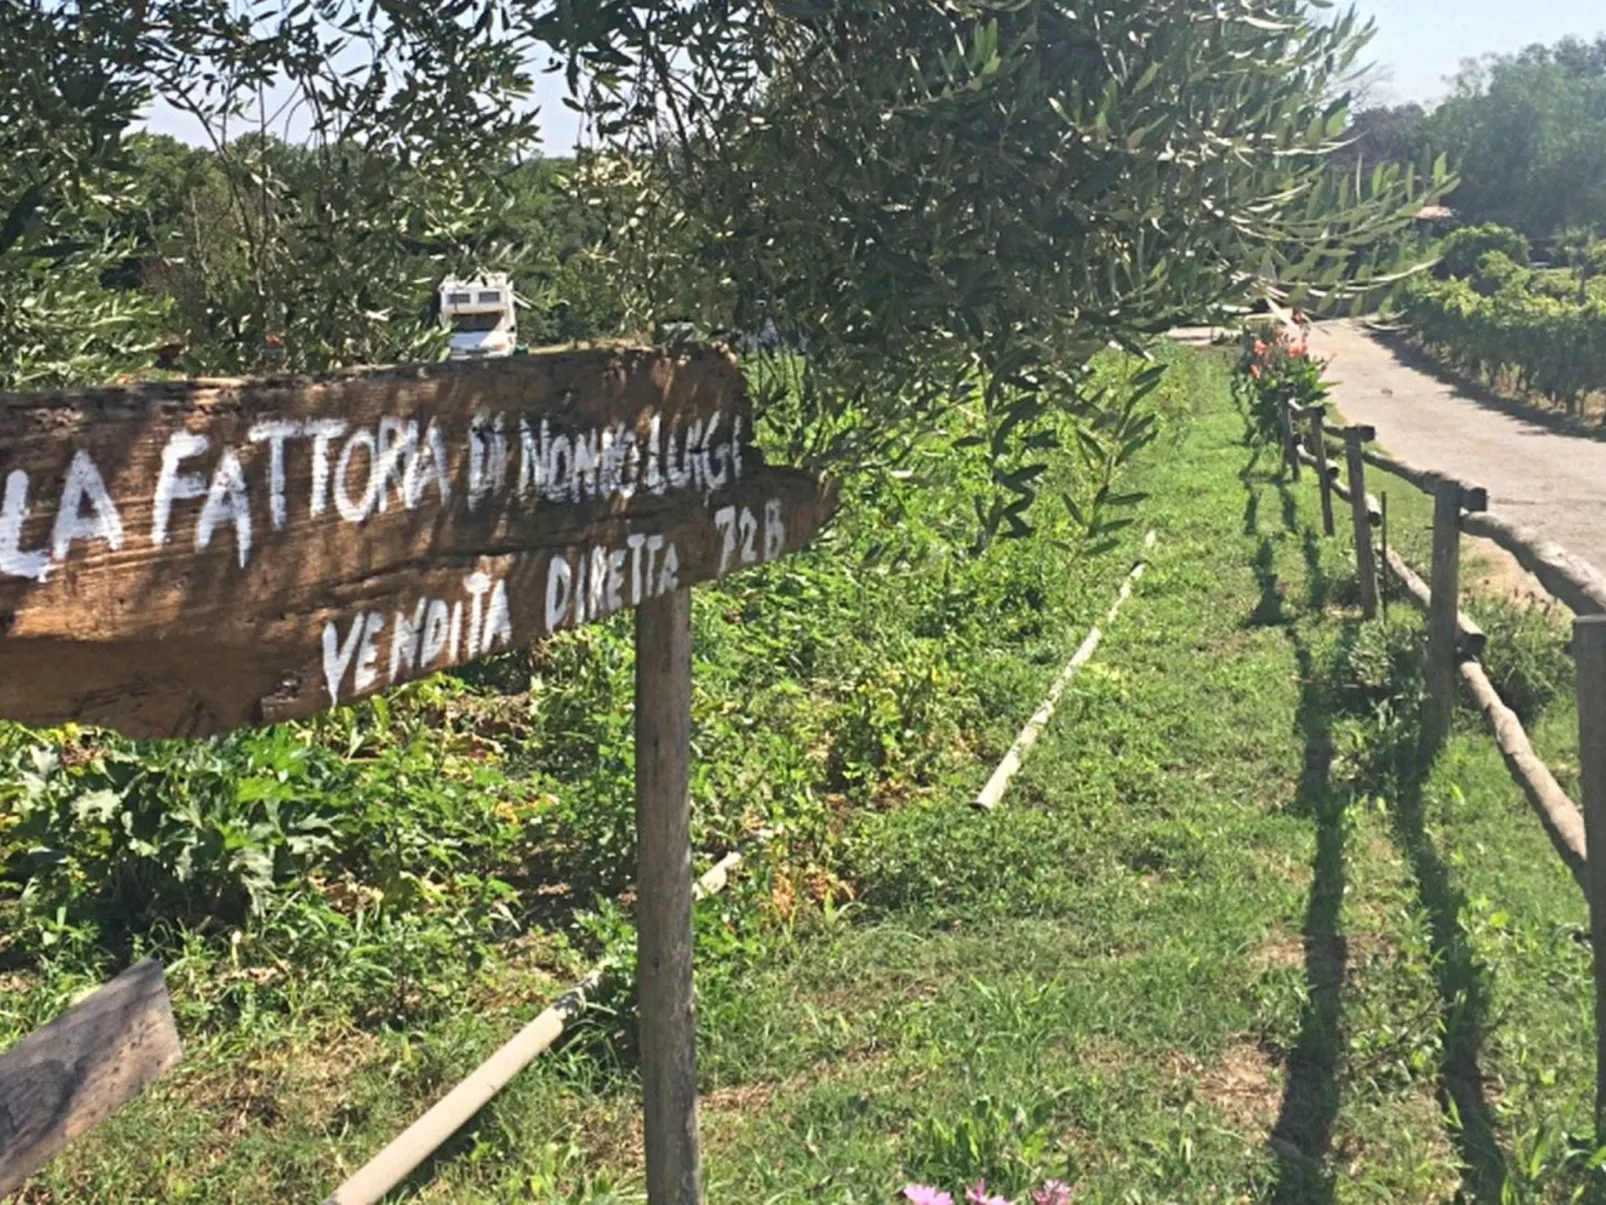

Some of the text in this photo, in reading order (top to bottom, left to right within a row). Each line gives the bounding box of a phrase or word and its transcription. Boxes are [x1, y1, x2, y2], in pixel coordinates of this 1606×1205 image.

[0, 449, 124, 583] LA
[148, 416, 453, 568] FATTORIA
[467, 408, 508, 512] DI
[321, 571, 513, 708] VENDITA
[545, 533, 681, 635] DIRETTA
